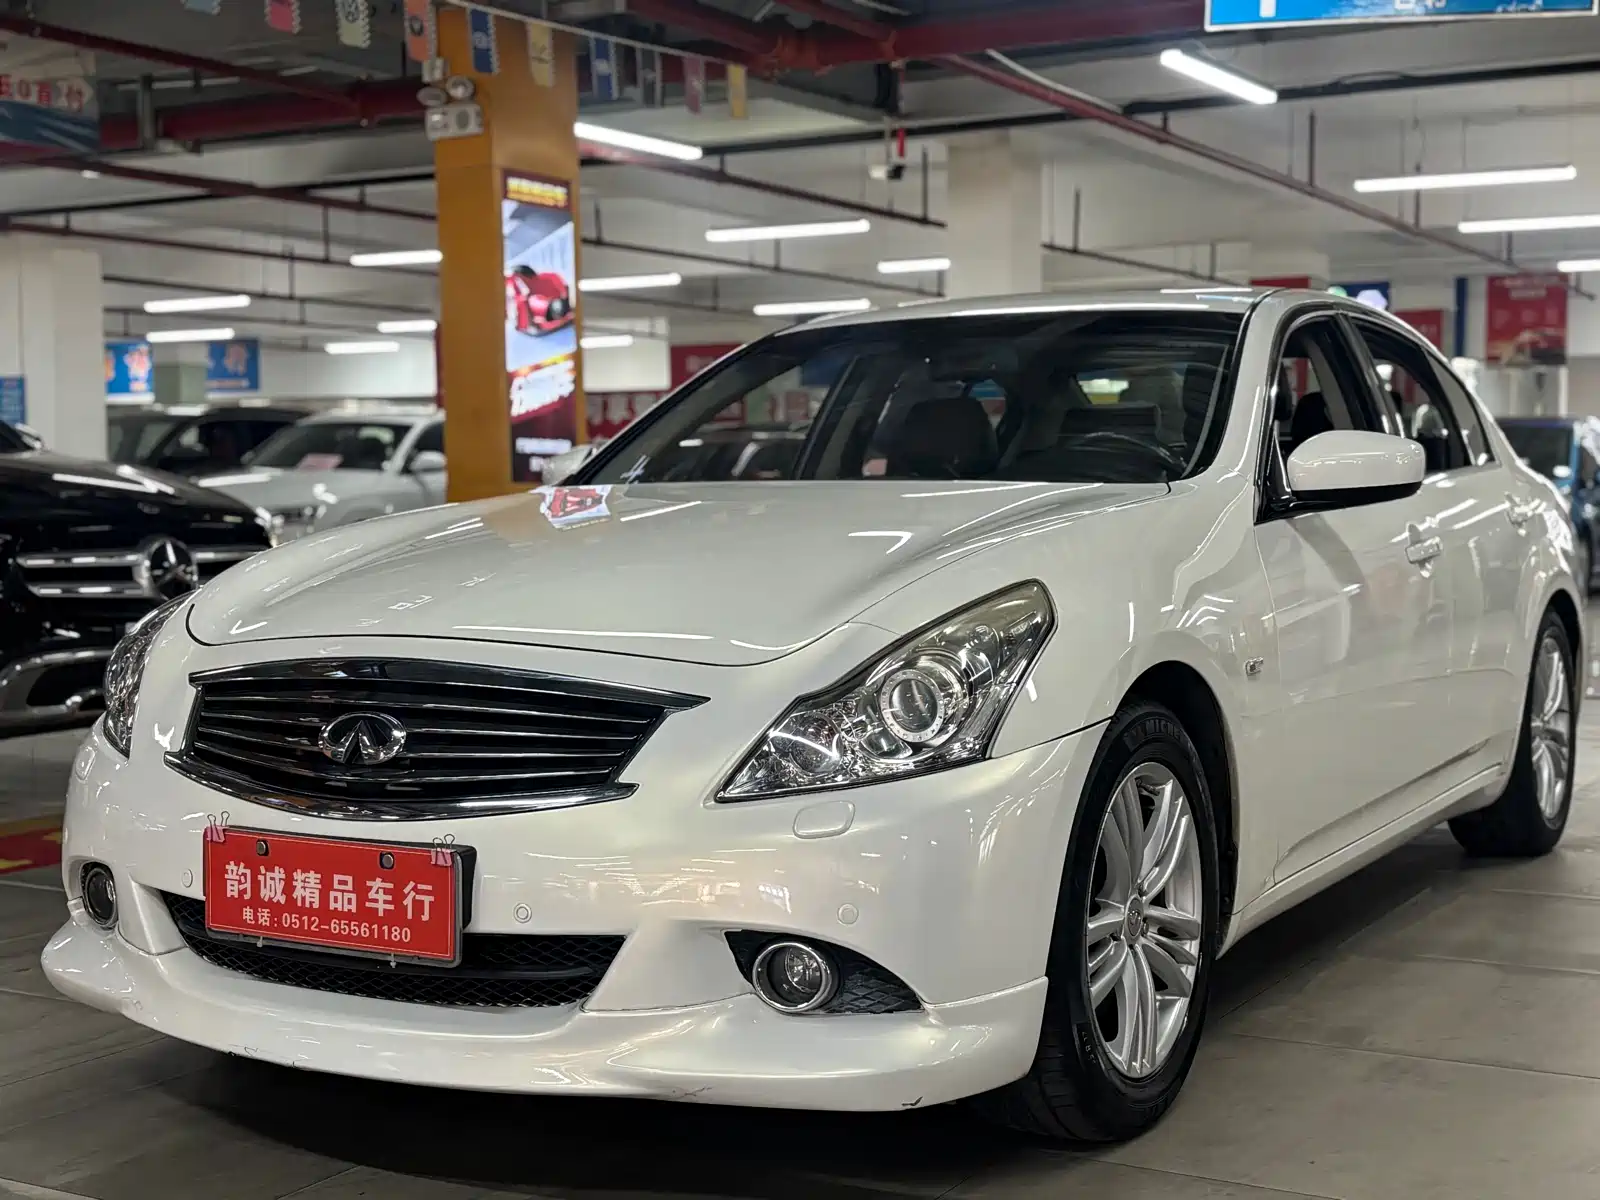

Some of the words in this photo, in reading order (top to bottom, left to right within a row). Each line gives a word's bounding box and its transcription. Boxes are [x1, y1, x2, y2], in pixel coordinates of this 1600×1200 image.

[224, 860, 435, 921] 韵诚精品车行
